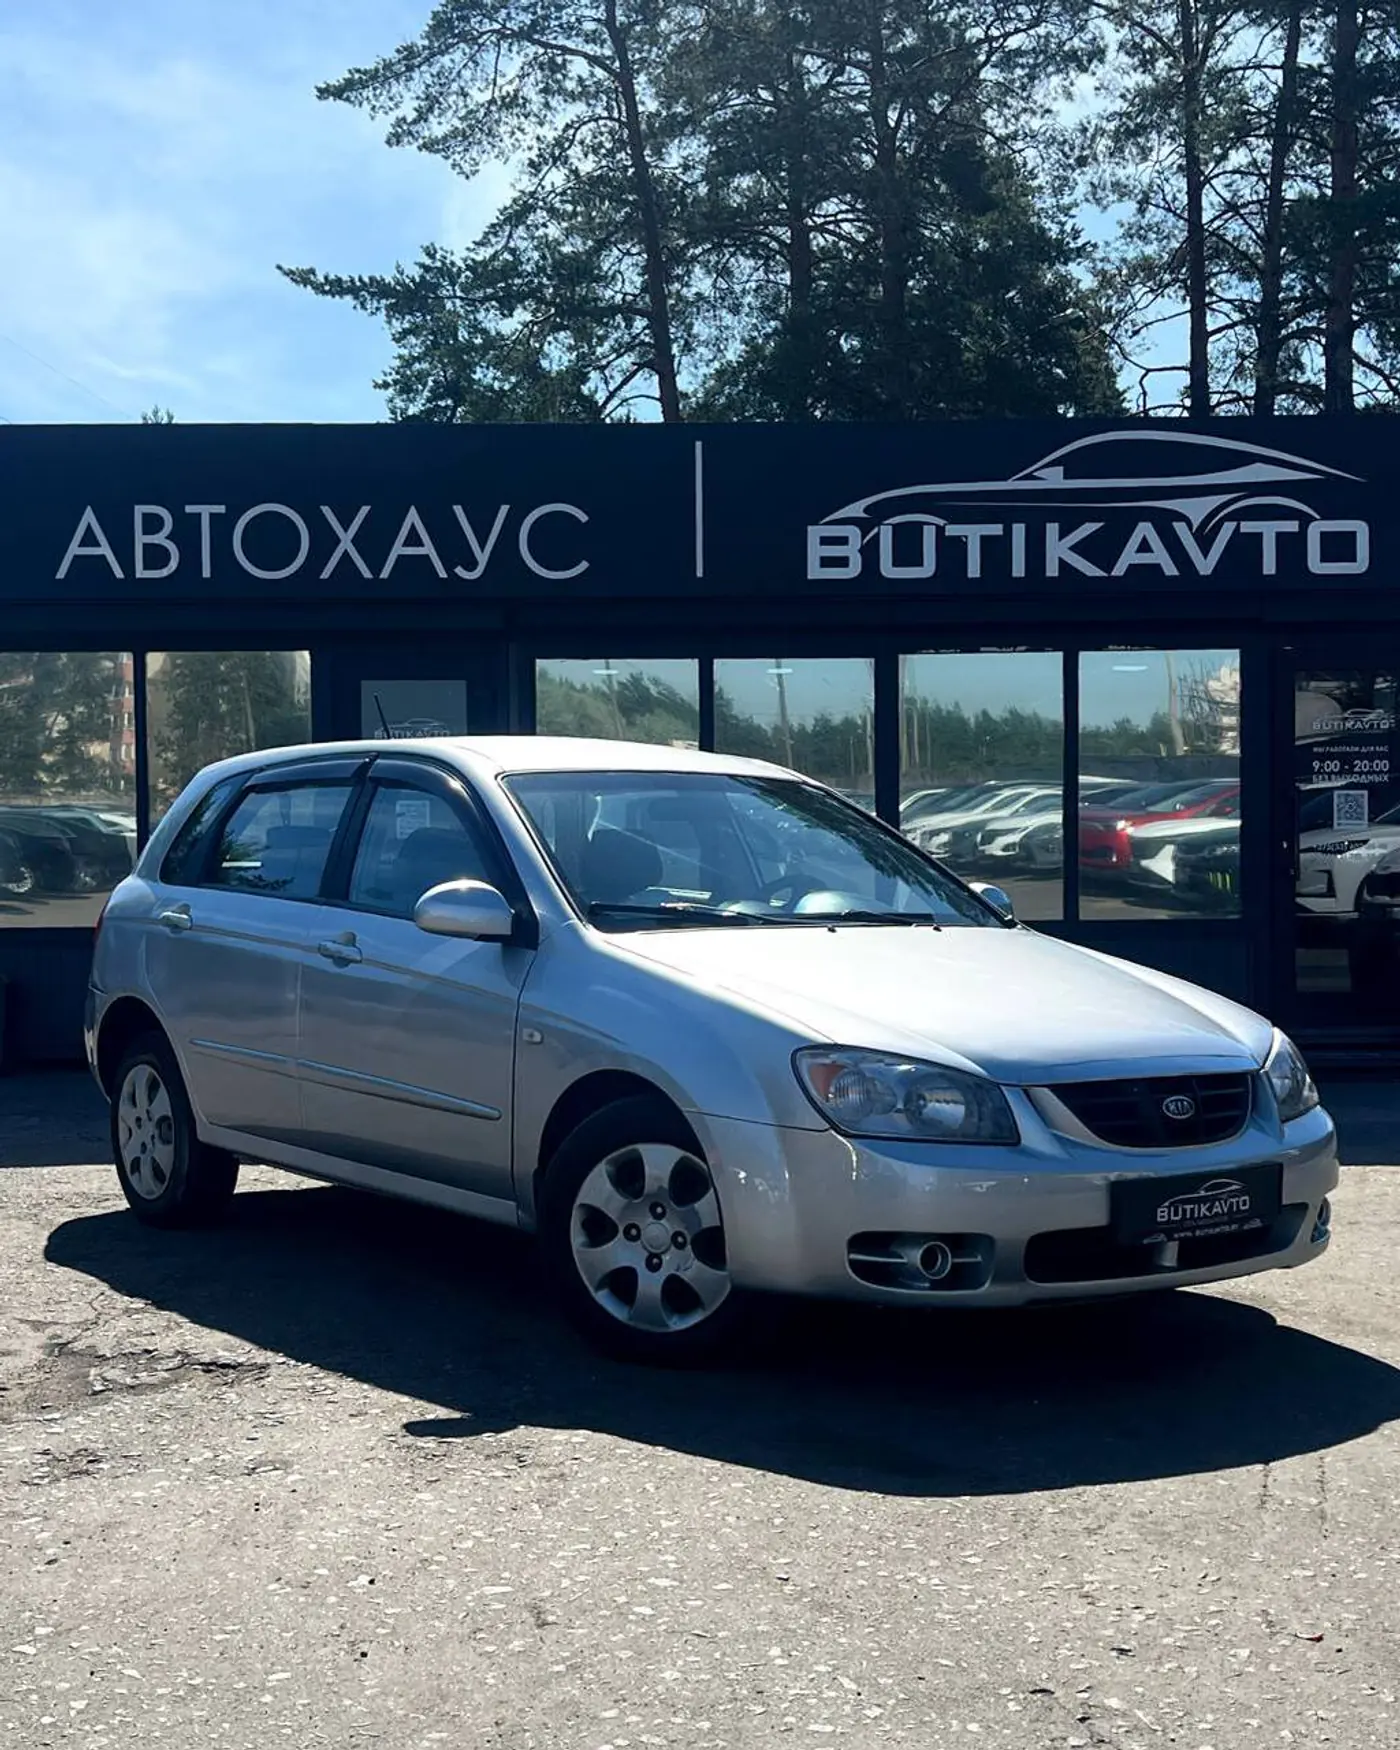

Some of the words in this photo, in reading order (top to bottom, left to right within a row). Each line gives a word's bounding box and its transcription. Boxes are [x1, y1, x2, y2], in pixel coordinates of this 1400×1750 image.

[55, 503, 590, 581] АВТОХАУС
[806, 519, 1370, 580] BUTIKAVTO
[1312, 760, 1340, 773] 9:00
[1353, 760, 1390, 772] 20:00
[1156, 1195, 1250, 1222] BUTIKAVTO
